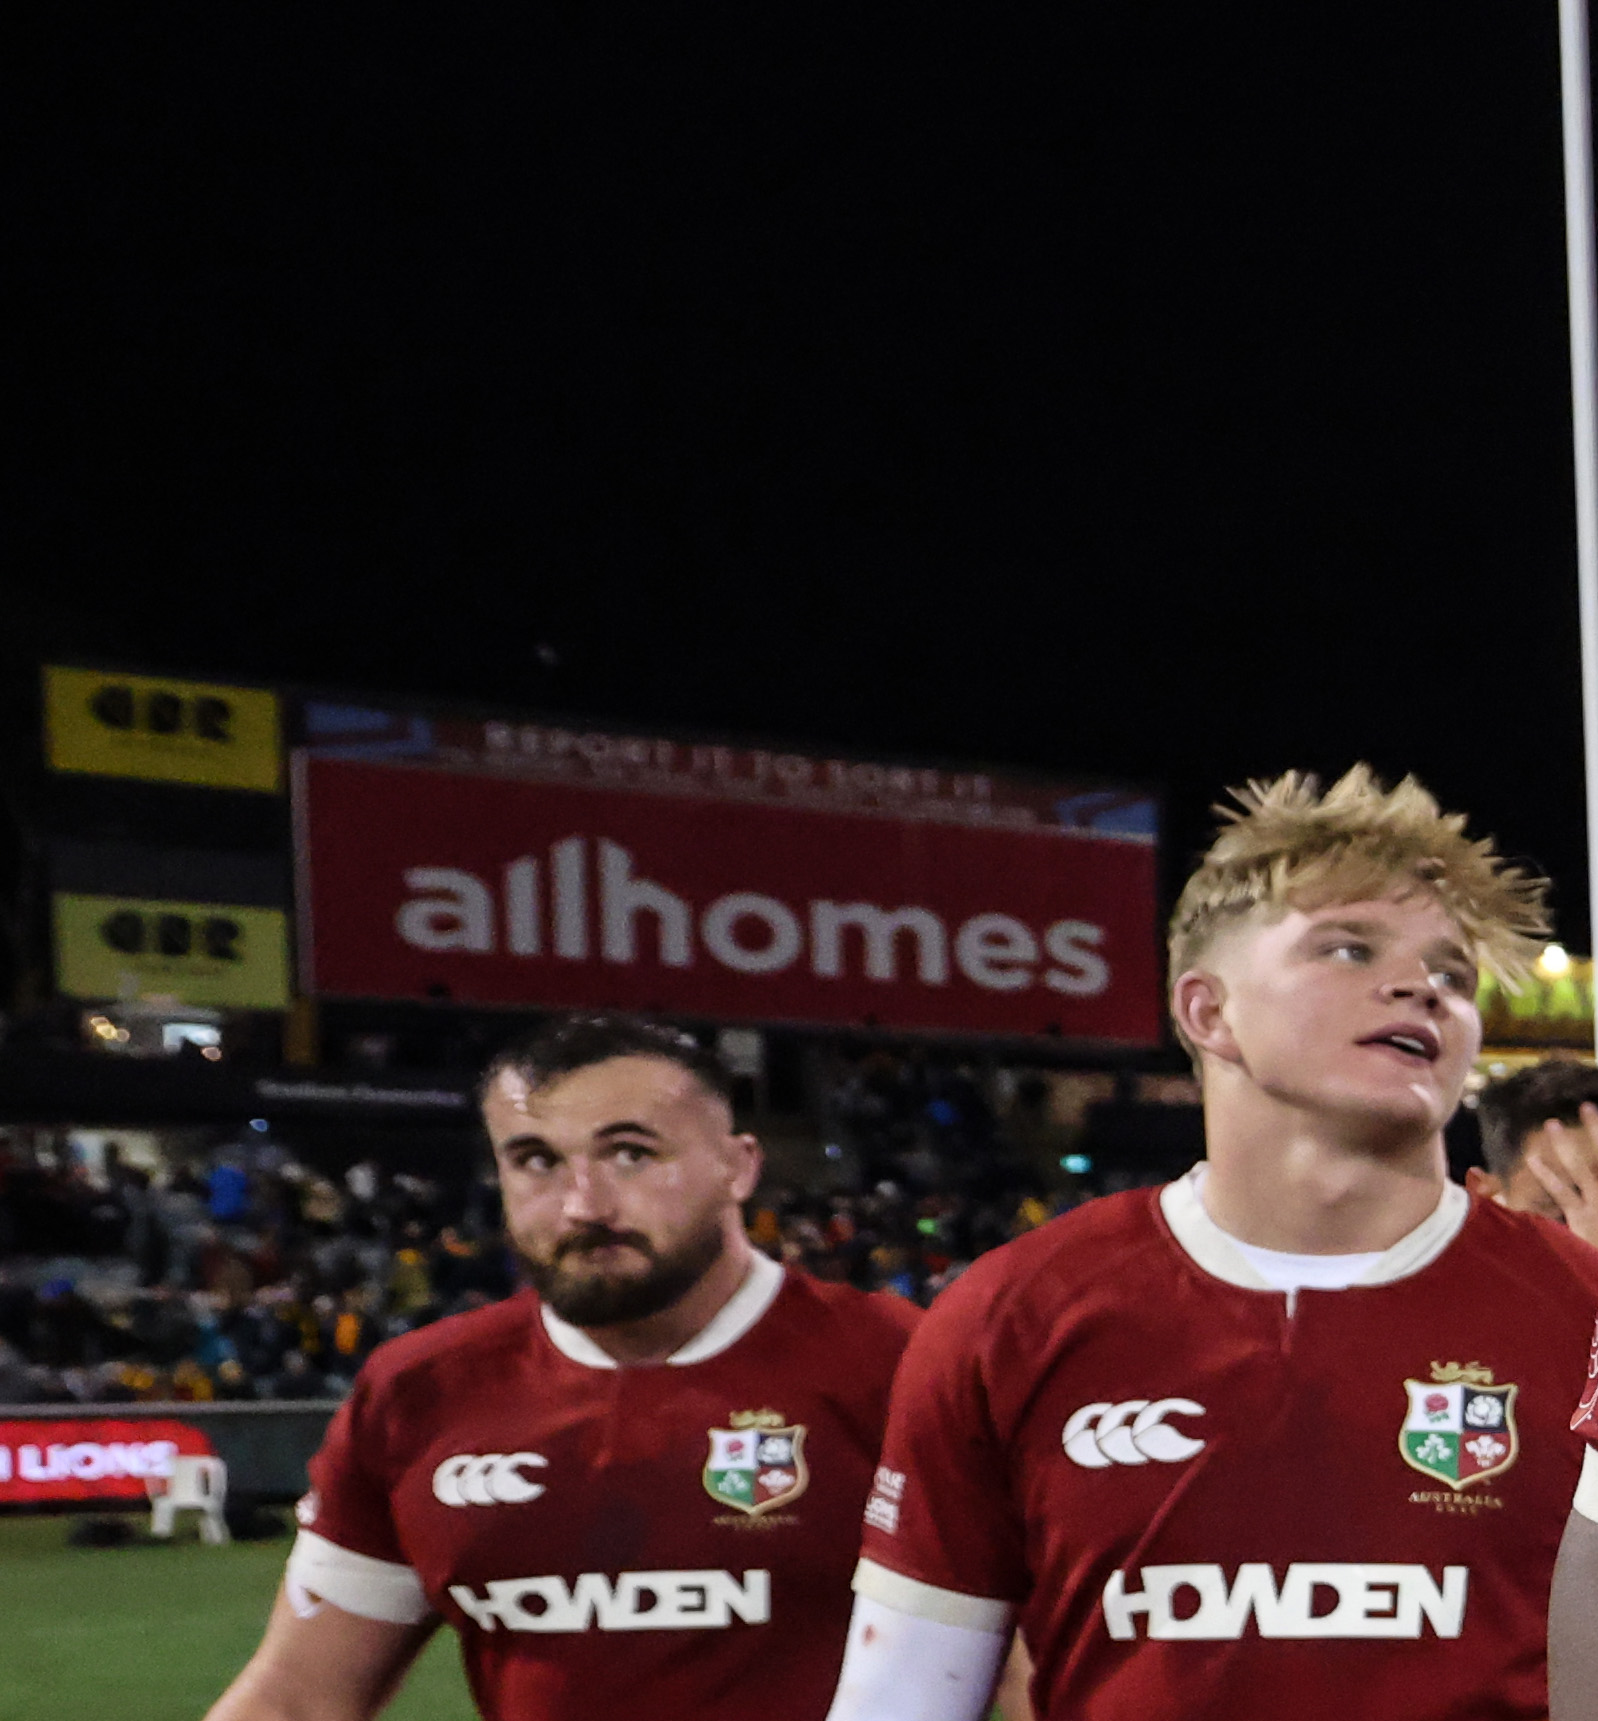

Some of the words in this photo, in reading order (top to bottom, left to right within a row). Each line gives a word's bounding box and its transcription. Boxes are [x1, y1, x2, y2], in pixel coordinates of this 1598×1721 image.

[395, 834, 1111, 998] allhomes
[18, 1440, 178, 1482] LIONS
[449, 1568, 771, 1633] HOWDEN
[1102, 1562, 1469, 1642] HOWDEN
